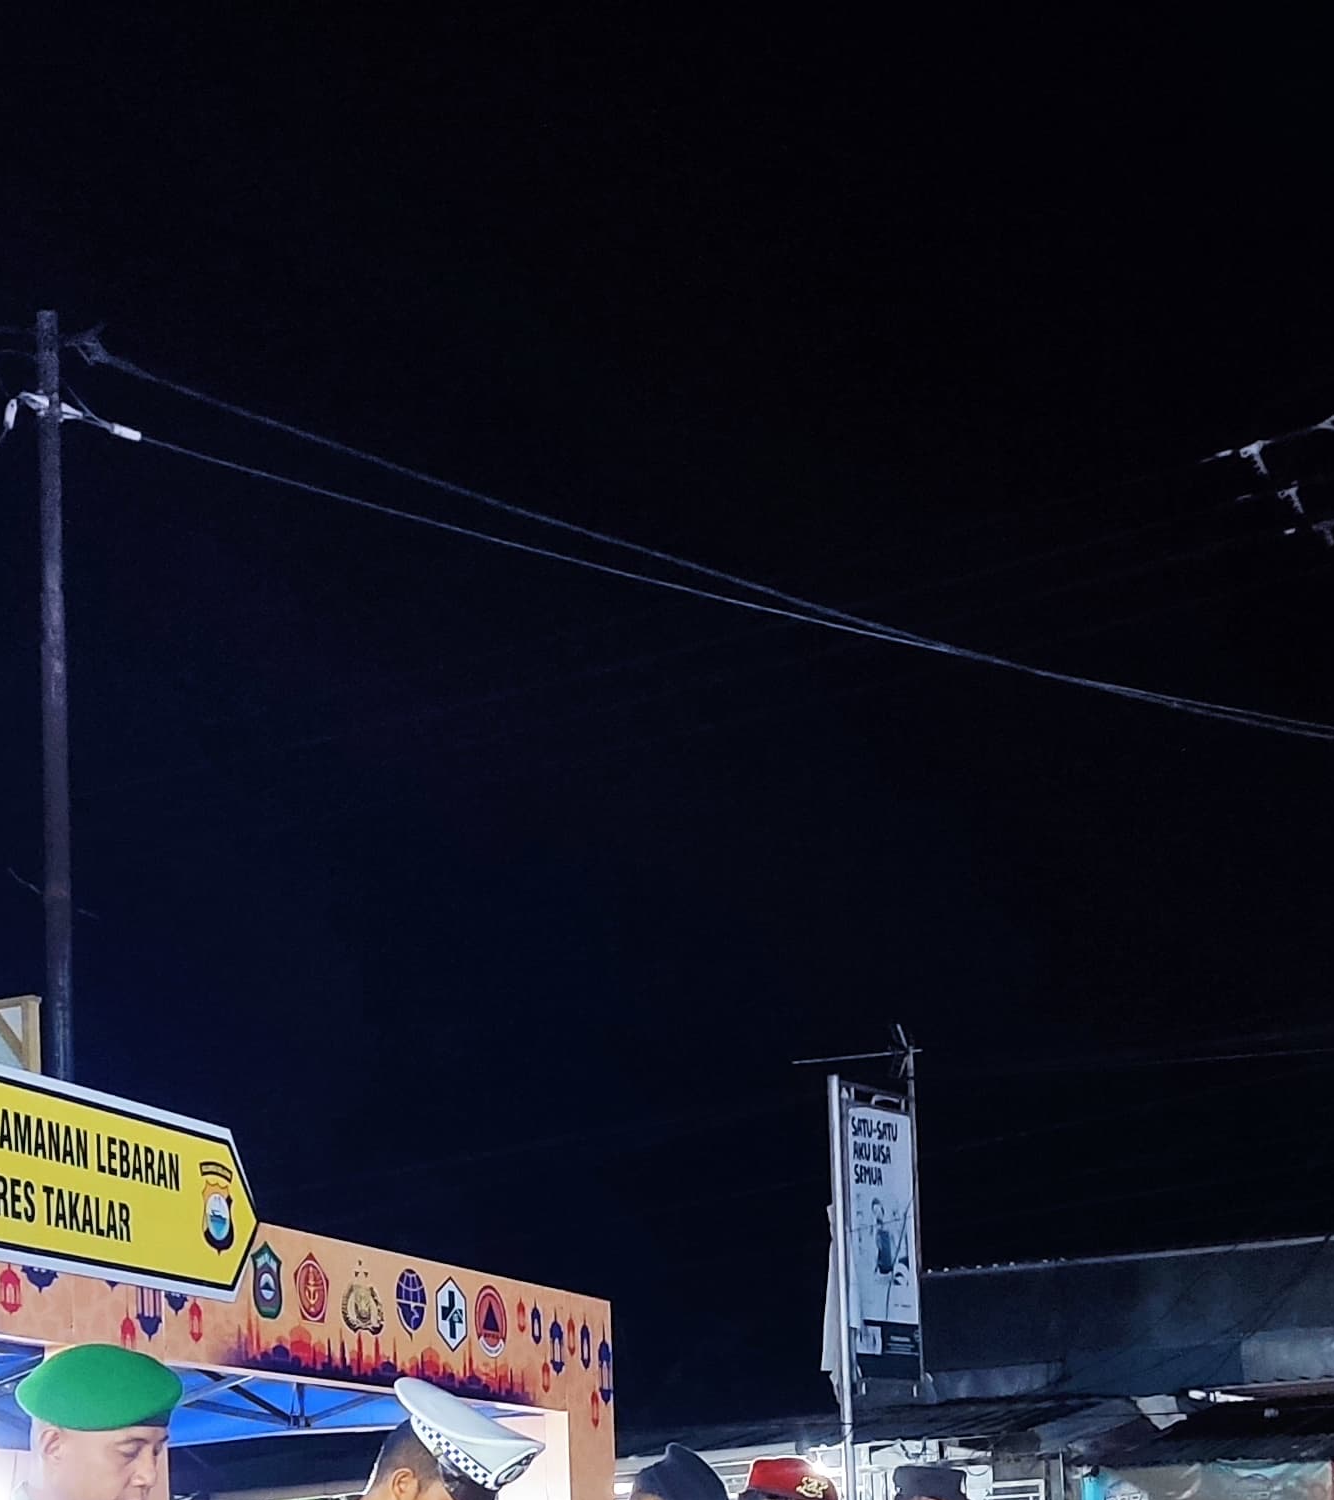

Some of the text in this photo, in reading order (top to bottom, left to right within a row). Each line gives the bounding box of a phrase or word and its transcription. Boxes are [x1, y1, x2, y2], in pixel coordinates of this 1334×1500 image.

[851, 1116, 897, 1142] SATU-SATU
[95, 1133, 181, 1192] LEBARAN
[853, 1141, 891, 1164] AKU BISA
[854, 1164, 883, 1186] SEMUA
[42, 1185, 133, 1244] TAKALAR
